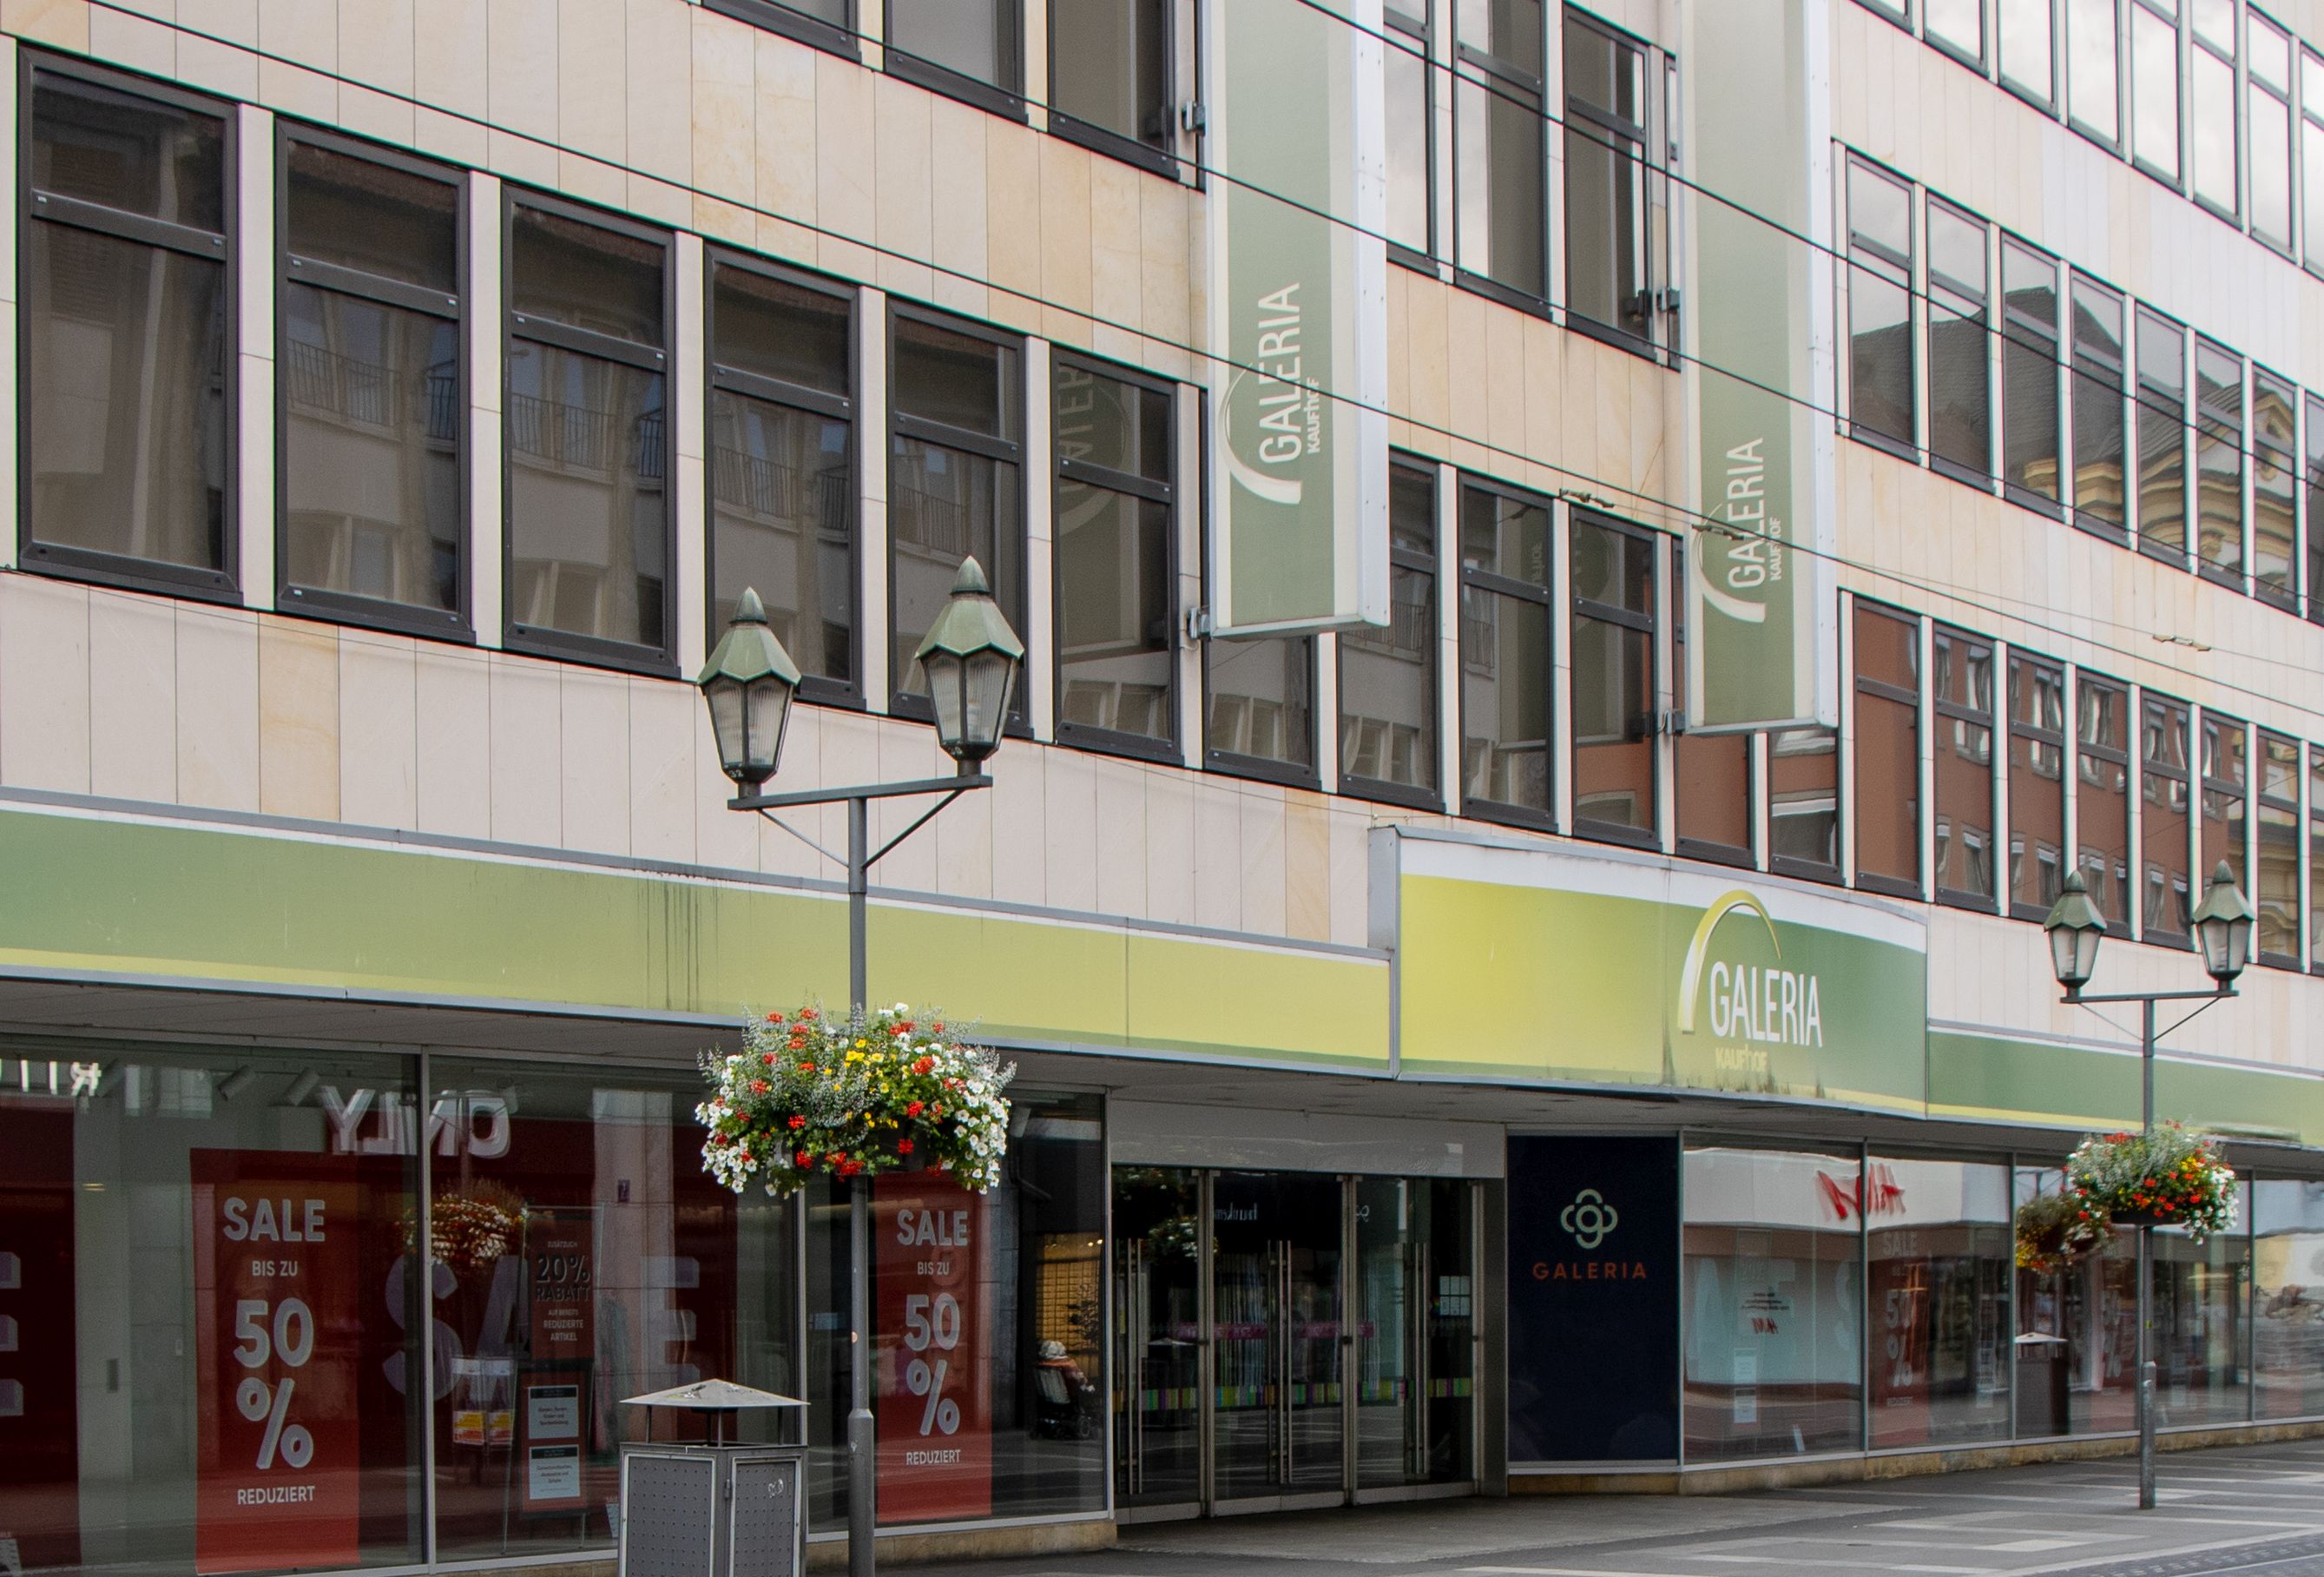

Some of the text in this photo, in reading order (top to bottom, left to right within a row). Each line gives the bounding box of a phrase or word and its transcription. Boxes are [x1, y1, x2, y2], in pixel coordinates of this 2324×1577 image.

[1258, 283, 1302, 464] GALERIA
[1709, 961, 1823, 1047] GALERIA
[222, 1196, 326, 1242] SALE
[897, 1209, 969, 1246] SALE
[1882, 1231, 1918, 1257] SALE
[251, 1260, 298, 1277] BIS ZU
[537, 1255, 591, 1283] 20%
[917, 1261, 950, 1276] BIS ZU
[1531, 1262, 1648, 1280] GALERIA
[536, 1285, 591, 1302] RABATT
[233, 1297, 314, 1369] 50
[543, 1319, 584, 1330] REDUZIERTE
[904, 1292, 961, 1351] 50
[550, 1331, 578, 1342] ARTIKEL
[905, 1358, 961, 1435] %
[236, 1376, 314, 1469] %
[905, 1449, 961, 1466] REDUZIERT
[237, 1486, 315, 1505] REDUZIERT
